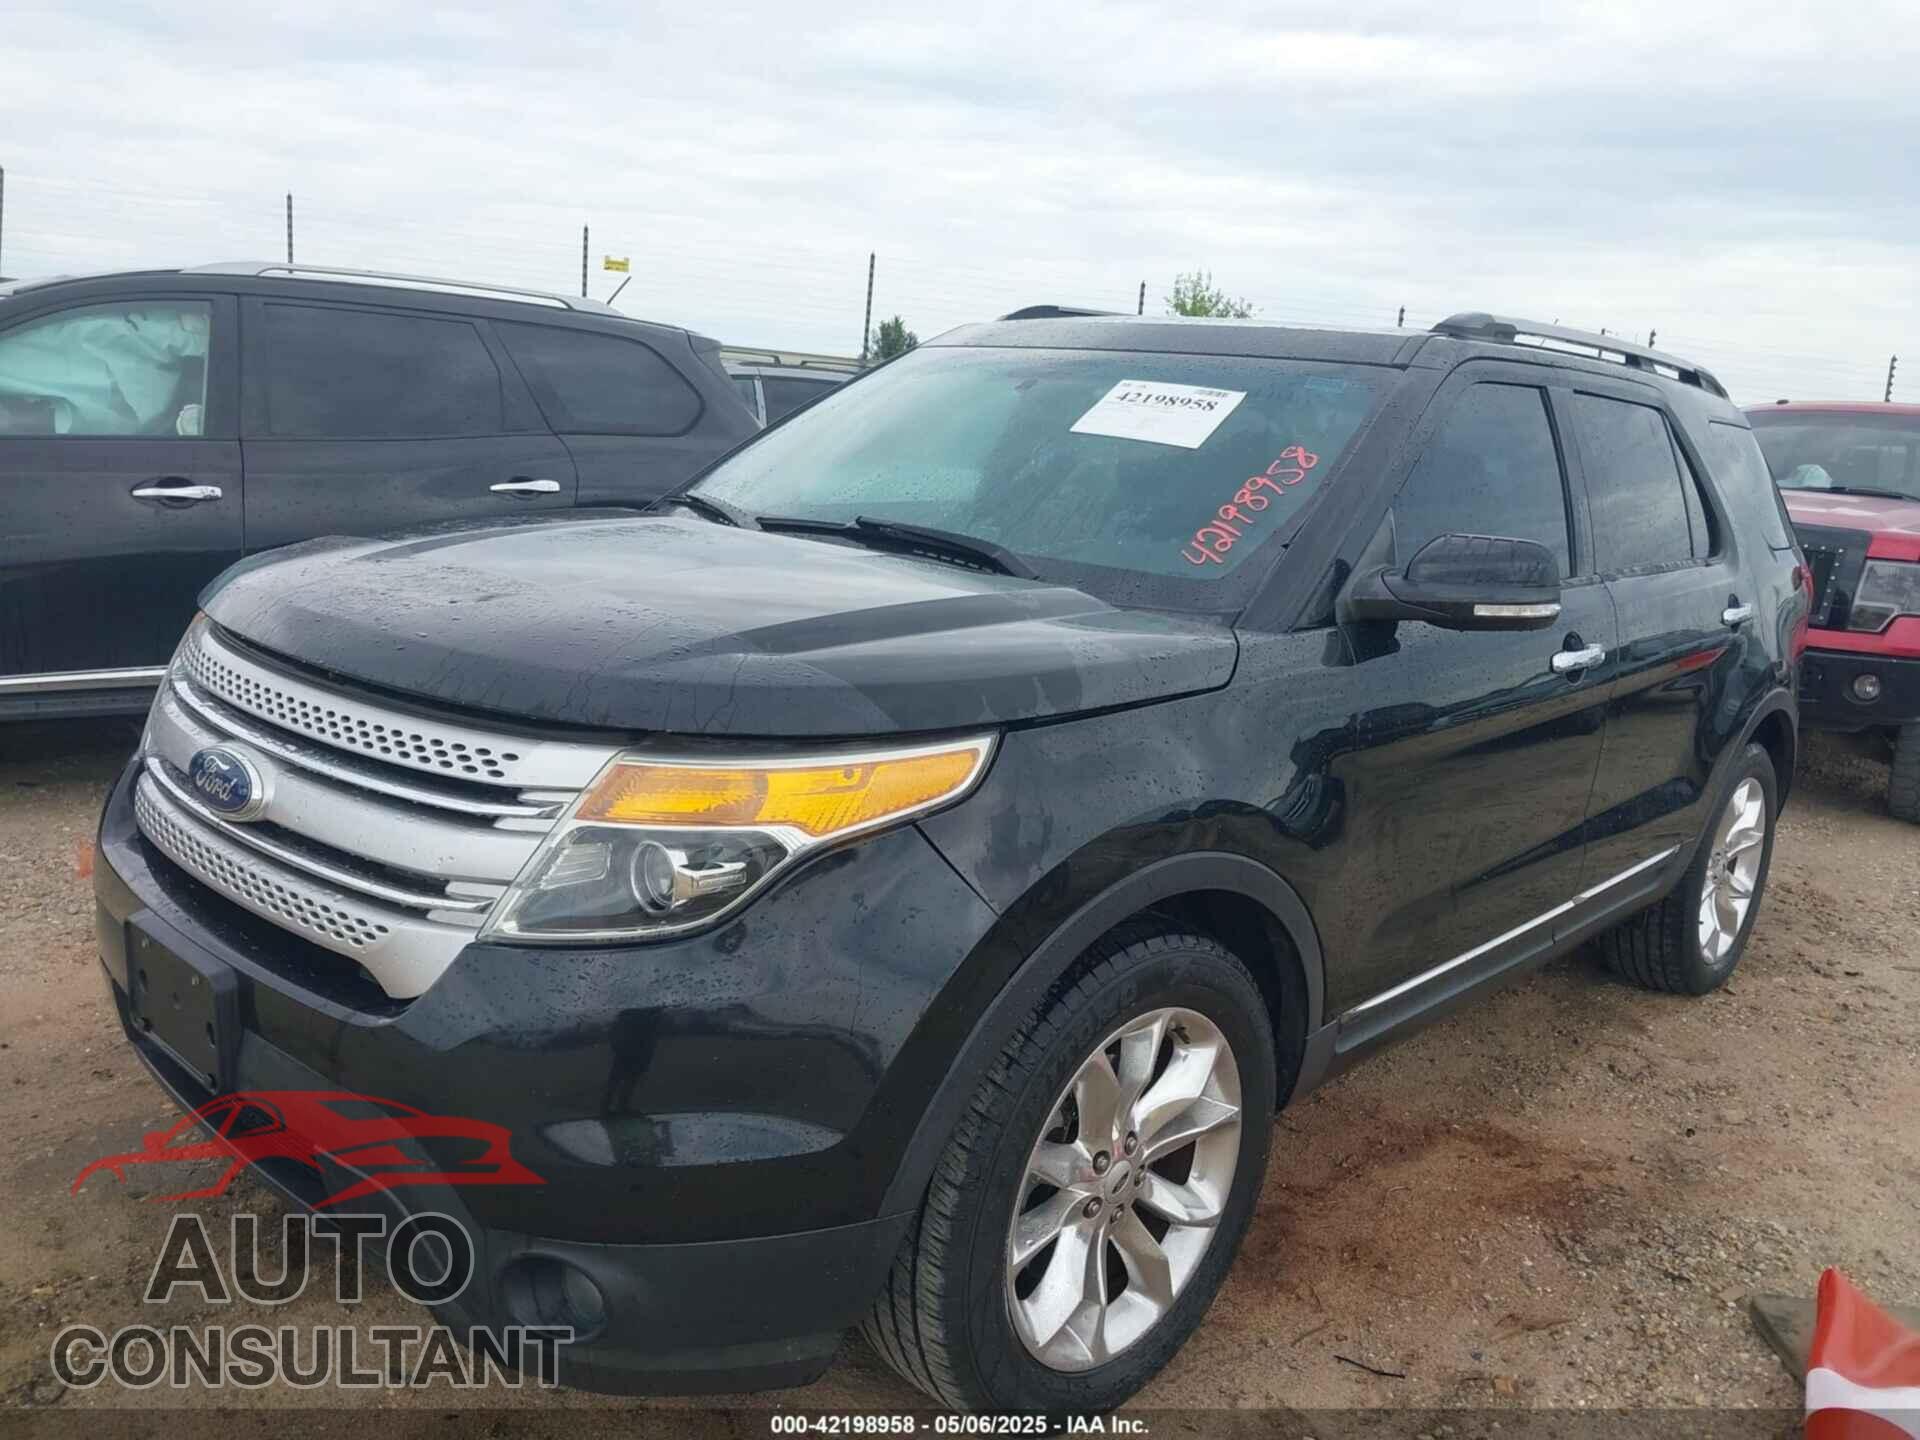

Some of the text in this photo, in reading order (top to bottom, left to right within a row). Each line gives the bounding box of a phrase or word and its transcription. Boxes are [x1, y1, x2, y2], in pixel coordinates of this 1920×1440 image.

[1115, 391, 1219, 412] 42198958
[1181, 445, 1319, 566] 42198958
[195, 755, 238, 801] Ford
